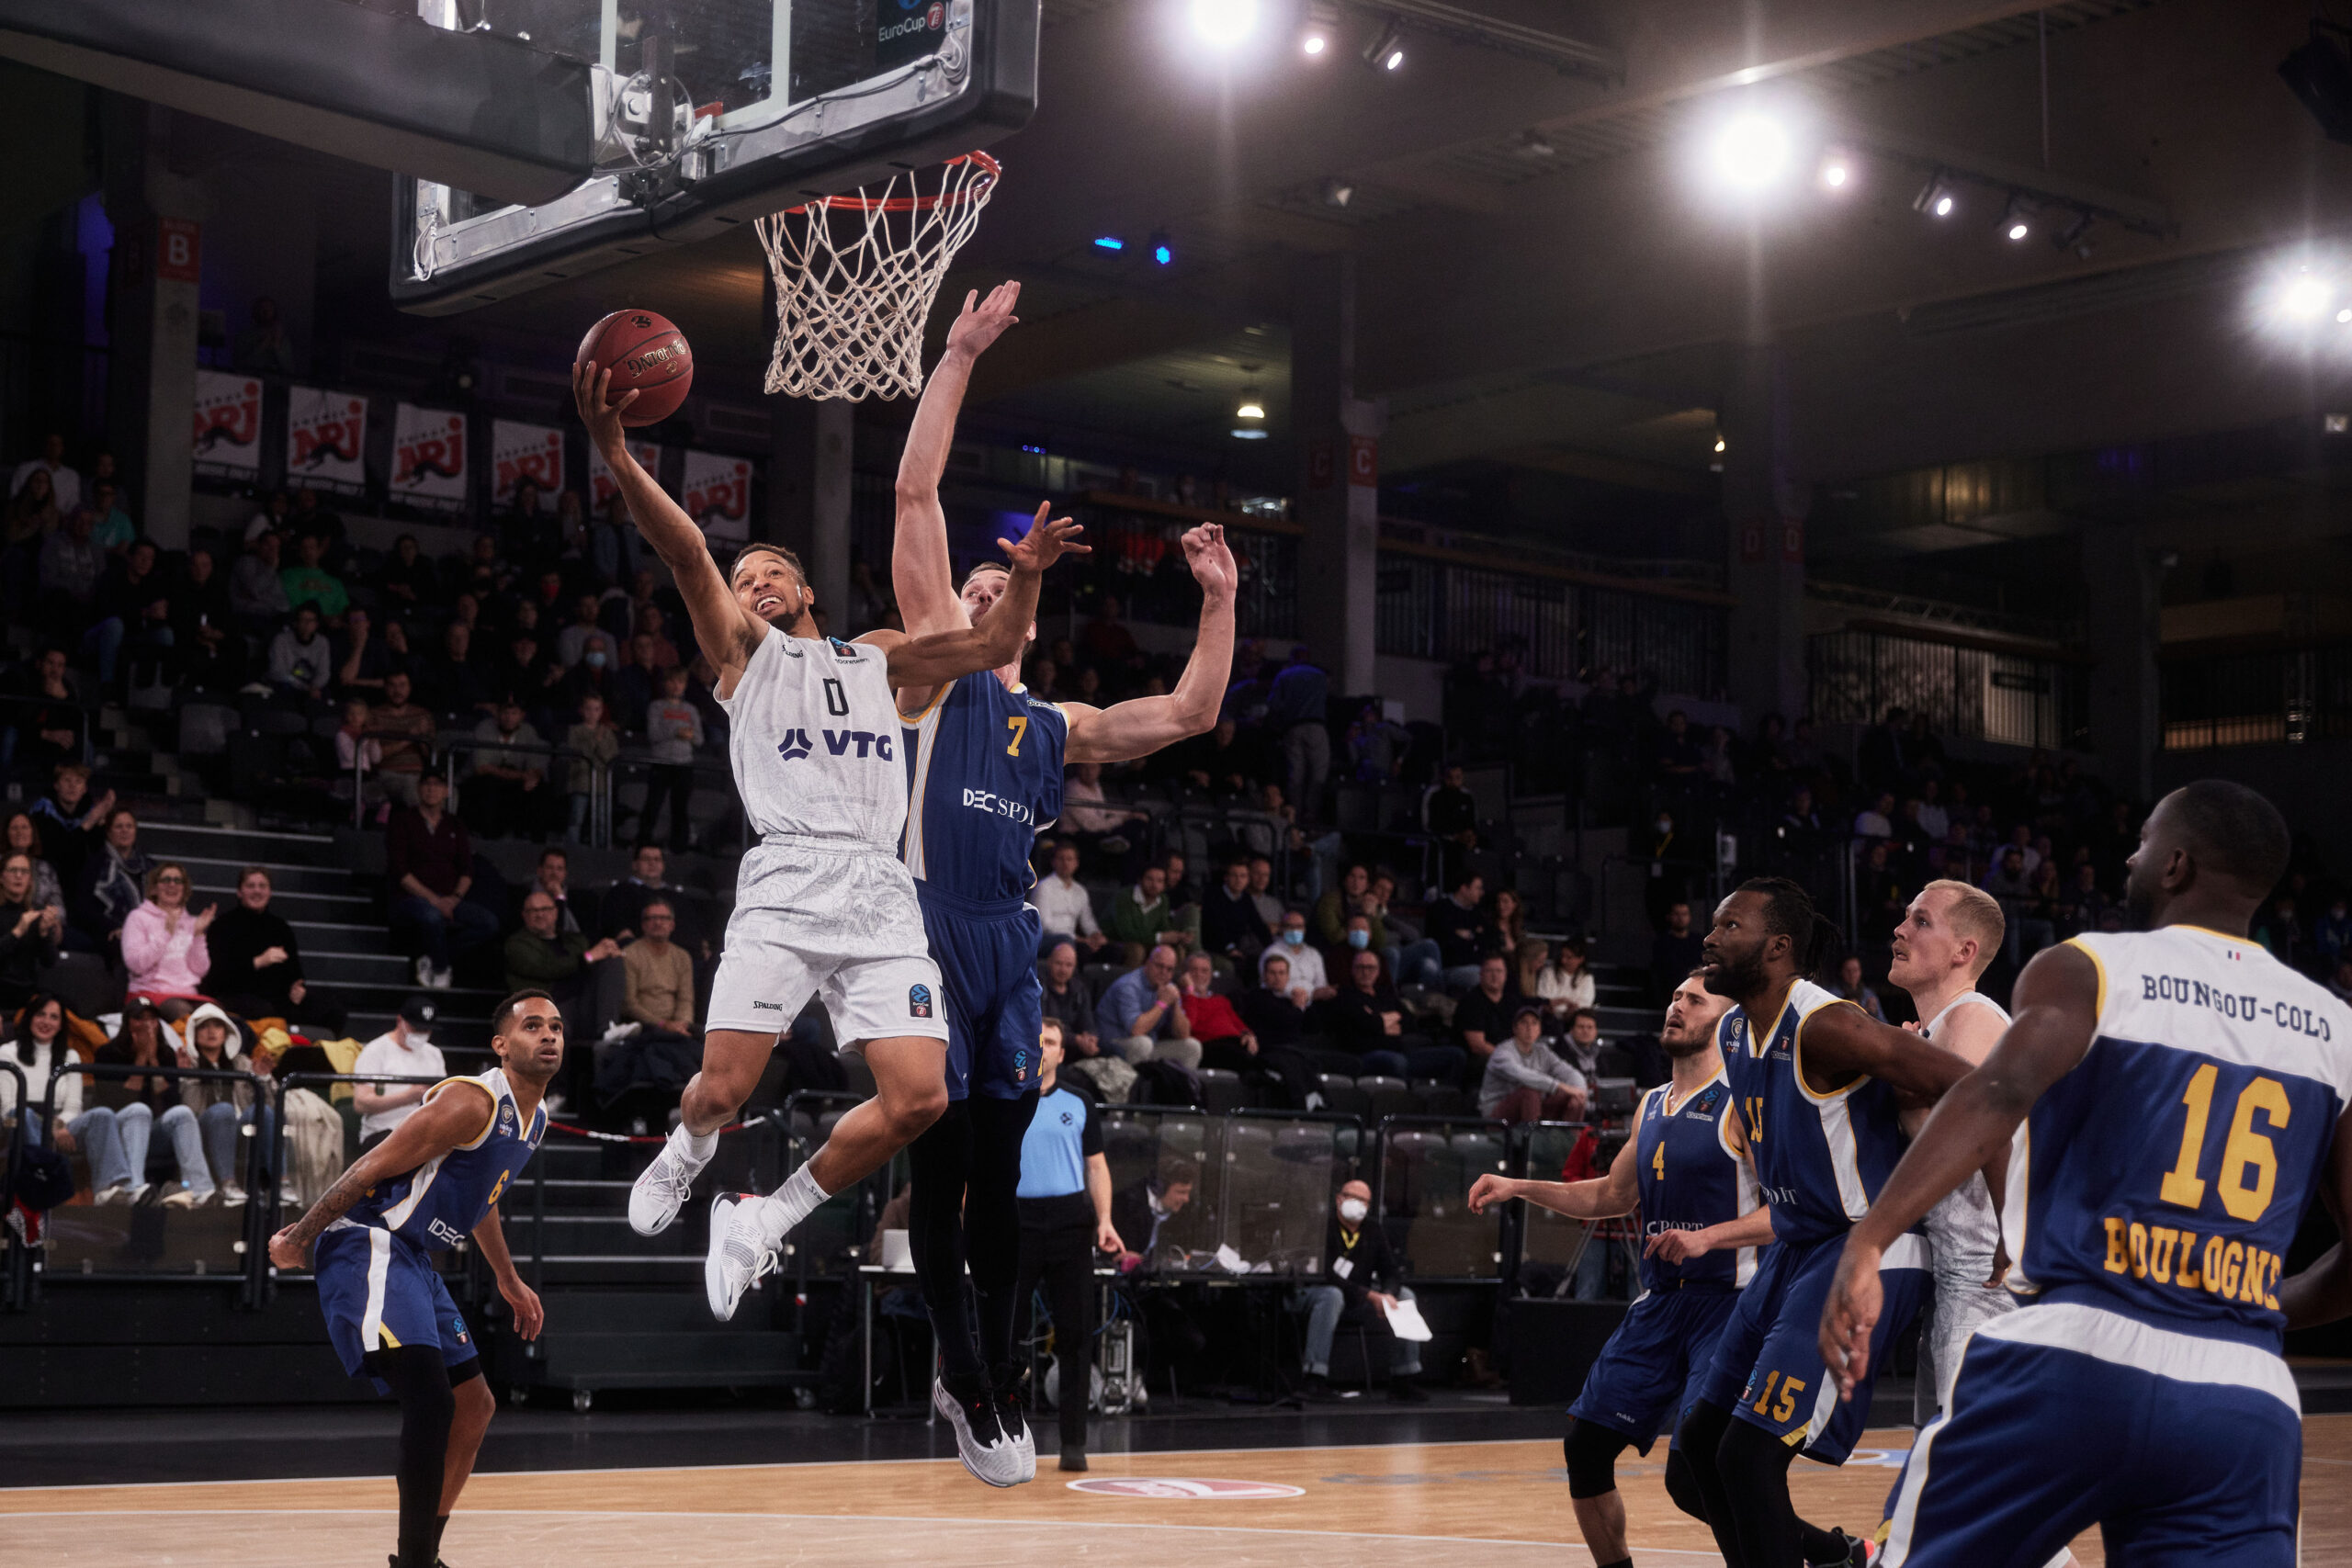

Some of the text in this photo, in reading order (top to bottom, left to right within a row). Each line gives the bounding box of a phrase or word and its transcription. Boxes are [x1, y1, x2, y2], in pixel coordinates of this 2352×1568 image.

[878, 17, 926, 42] EuroCup
[168, 233, 189, 266] B
[1357, 448, 1371, 475] C
[822, 678, 850, 716] 0
[822, 729, 893, 761] VTG
[1007, 716, 1028, 757] 7
[753, 1000, 783, 1012] SPALDING
[2141, 975, 2331, 1042] BOUNGOU-COLO
[1652, 1141, 1665, 1180] 4
[2159, 1063, 2291, 1223] 16
[488, 1169, 510, 1205] 6
[427, 1217, 466, 1247] IDEC
[1753, 1370, 1806, 1423] 15
